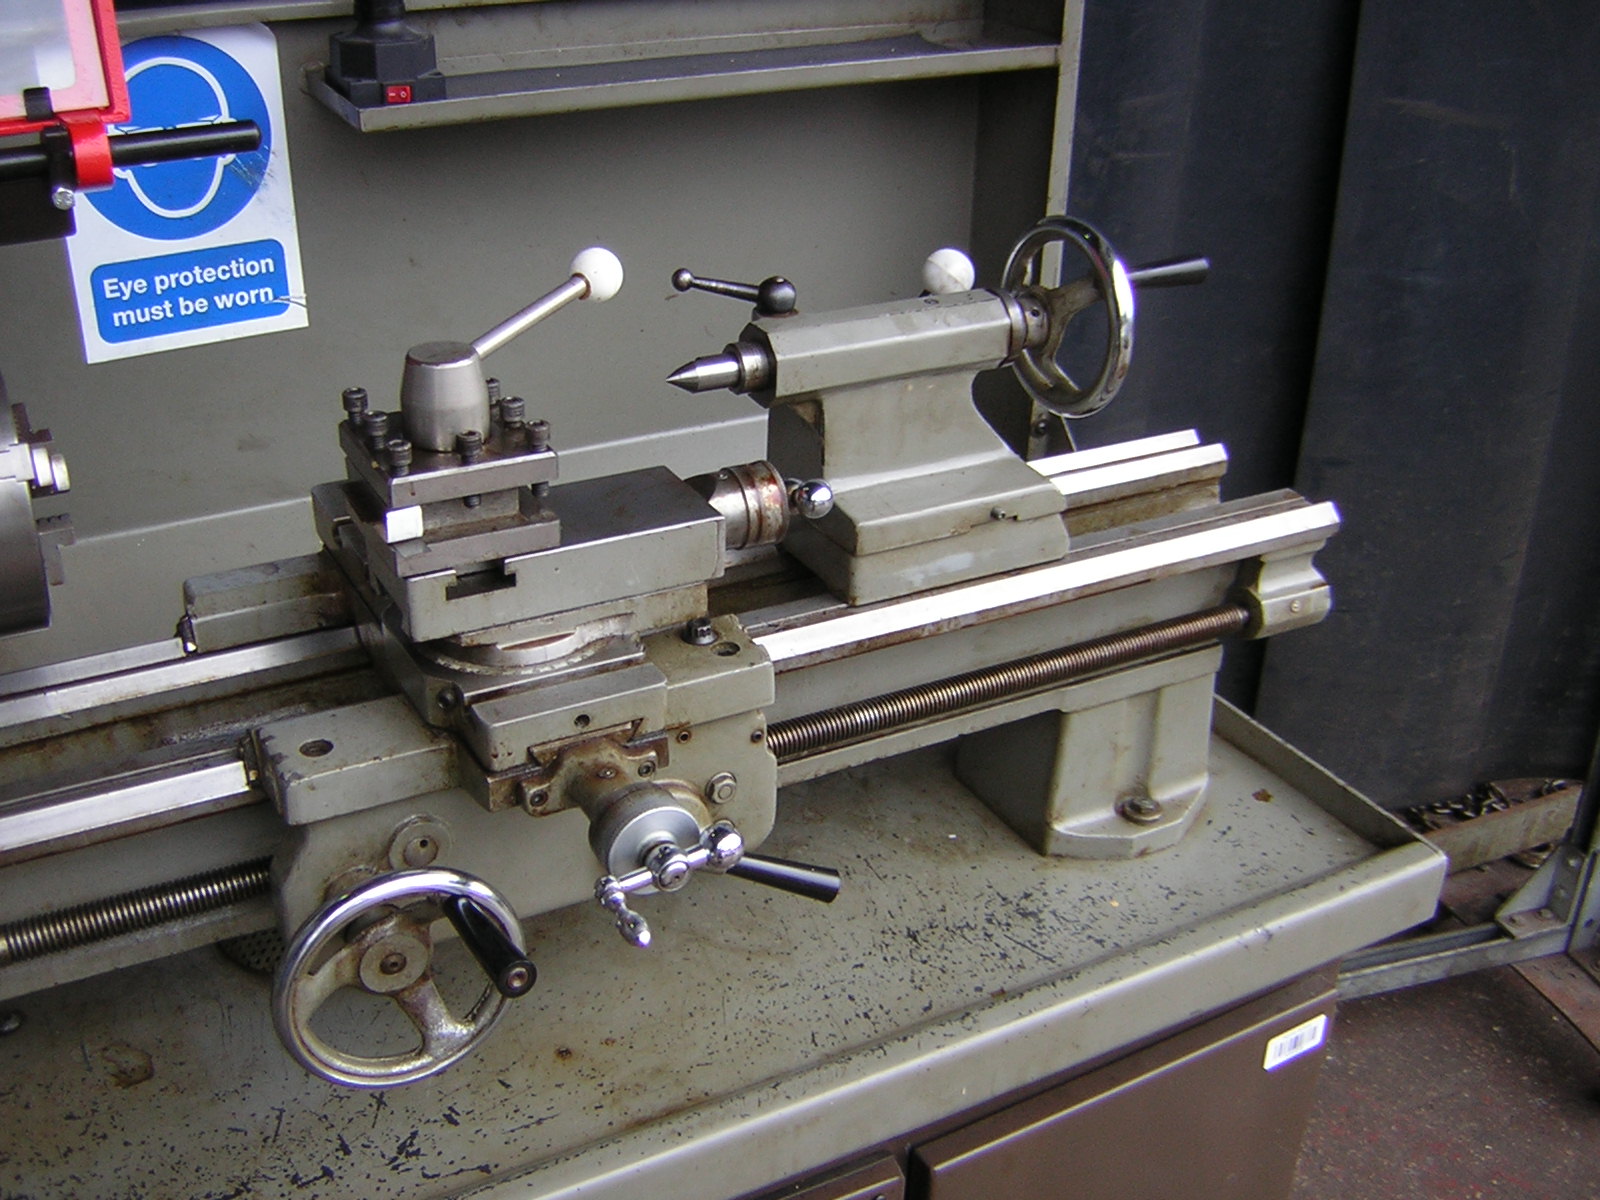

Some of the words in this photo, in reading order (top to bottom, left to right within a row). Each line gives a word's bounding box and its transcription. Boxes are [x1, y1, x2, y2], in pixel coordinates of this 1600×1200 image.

[103, 277, 148, 301] Eye
[154, 257, 275, 294] protection
[113, 300, 174, 327] must
[179, 296, 209, 316] be
[213, 286, 274, 309] worn
